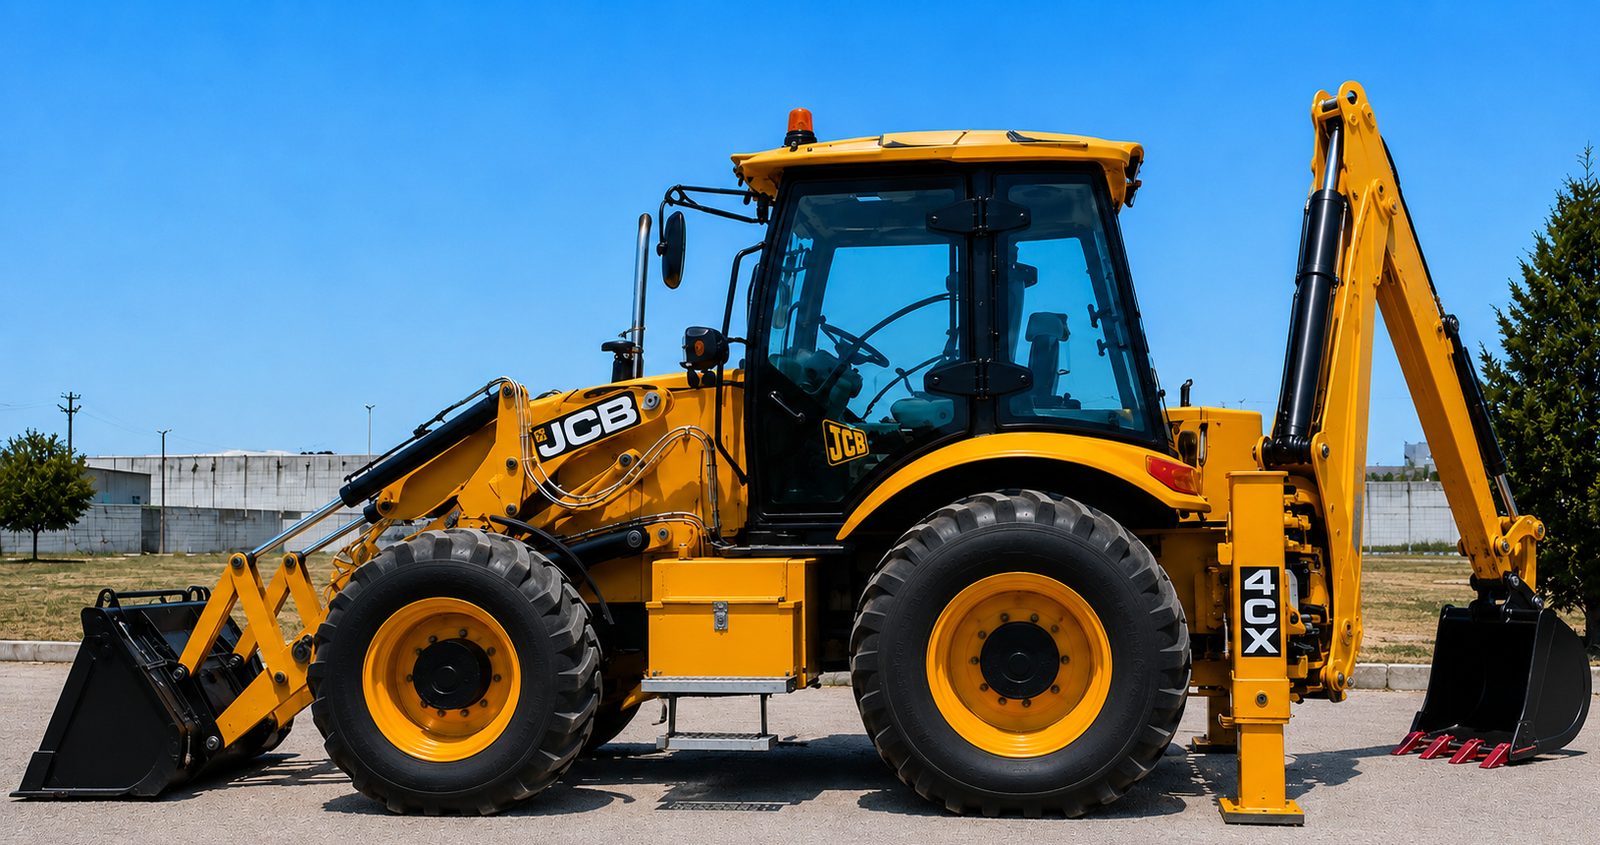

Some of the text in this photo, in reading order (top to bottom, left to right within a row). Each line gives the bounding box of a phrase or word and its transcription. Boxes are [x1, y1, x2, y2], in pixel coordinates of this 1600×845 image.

[538, 395, 638, 457] JCB
[828, 424, 867, 461] JCB
[1243, 569, 1279, 654] 4CX
